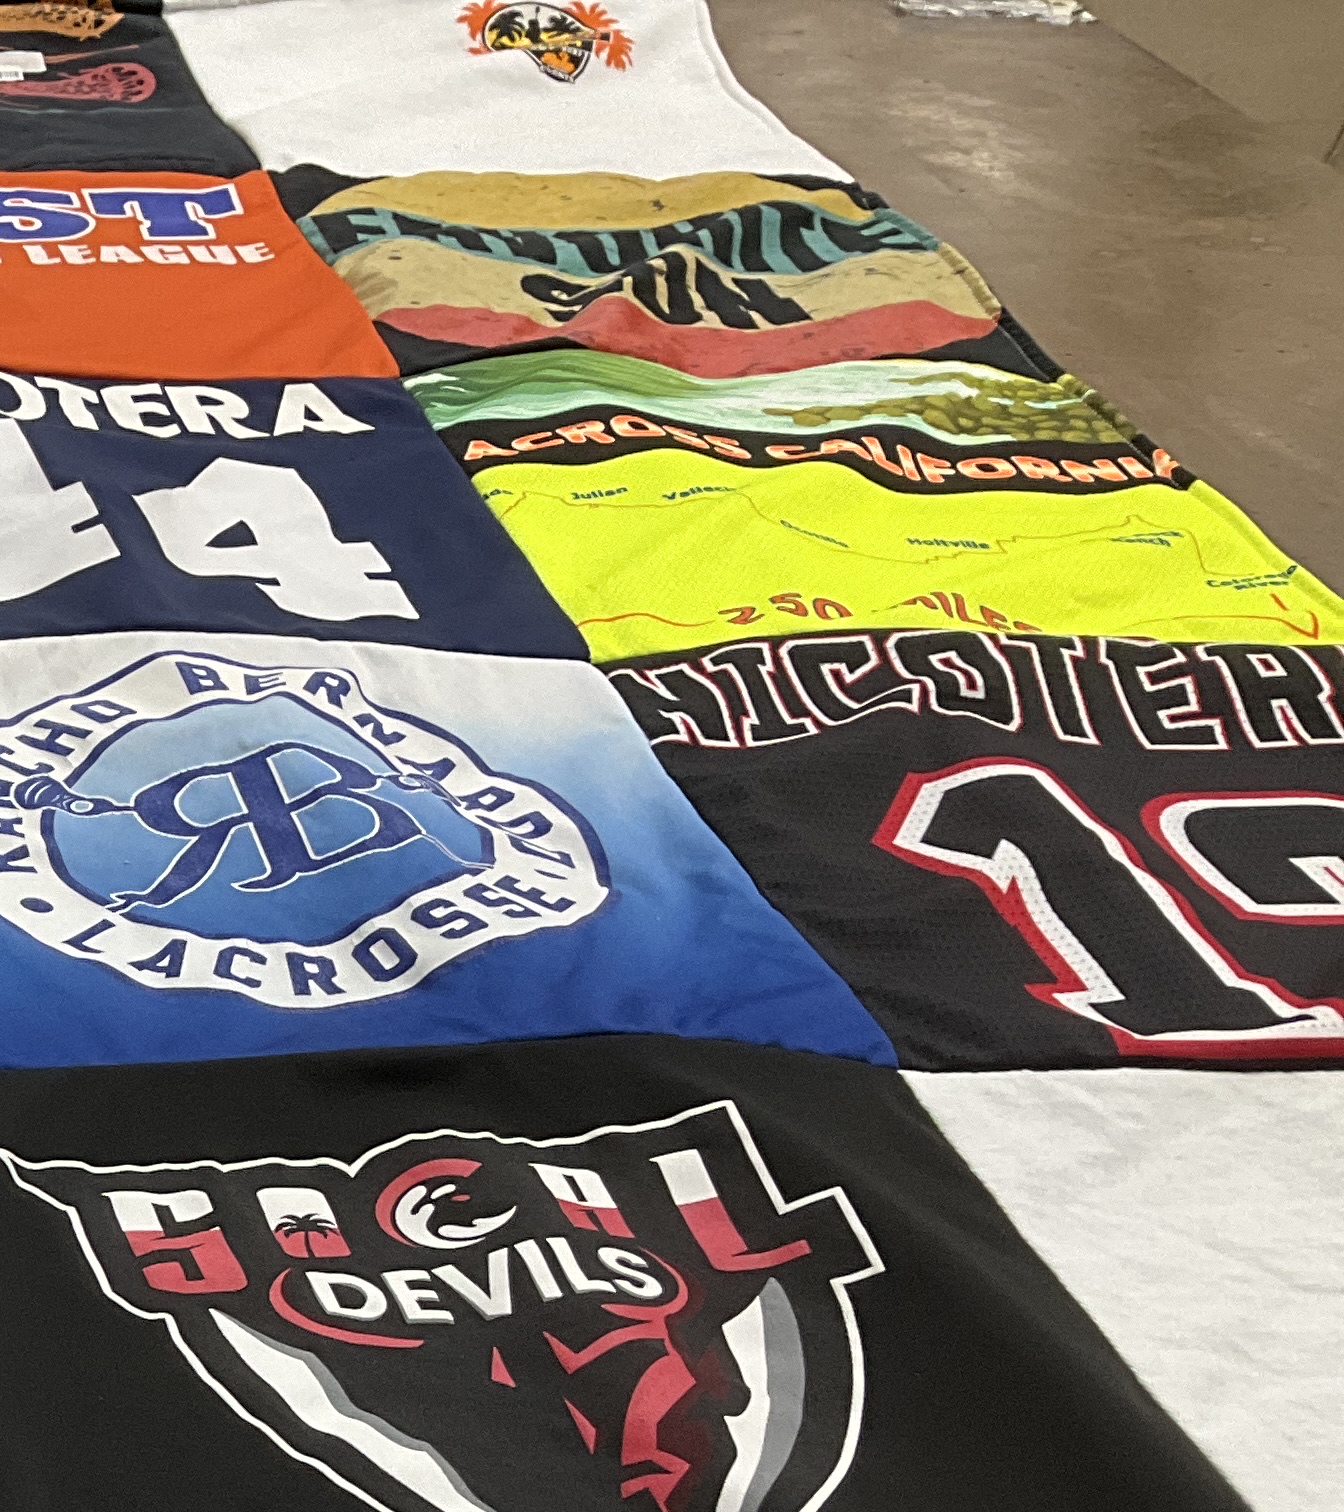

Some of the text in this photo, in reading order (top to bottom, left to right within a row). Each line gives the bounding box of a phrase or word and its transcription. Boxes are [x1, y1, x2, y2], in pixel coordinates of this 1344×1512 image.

[26, 243, 274, 265] LEAGUE
[464, 415, 1182, 484] ACROSS CALIFORNIA
[571, 487, 628, 500] Julian
[64, 873, 574, 998] LACROSSE
[310, 1236, 670, 1326] DEVILS
